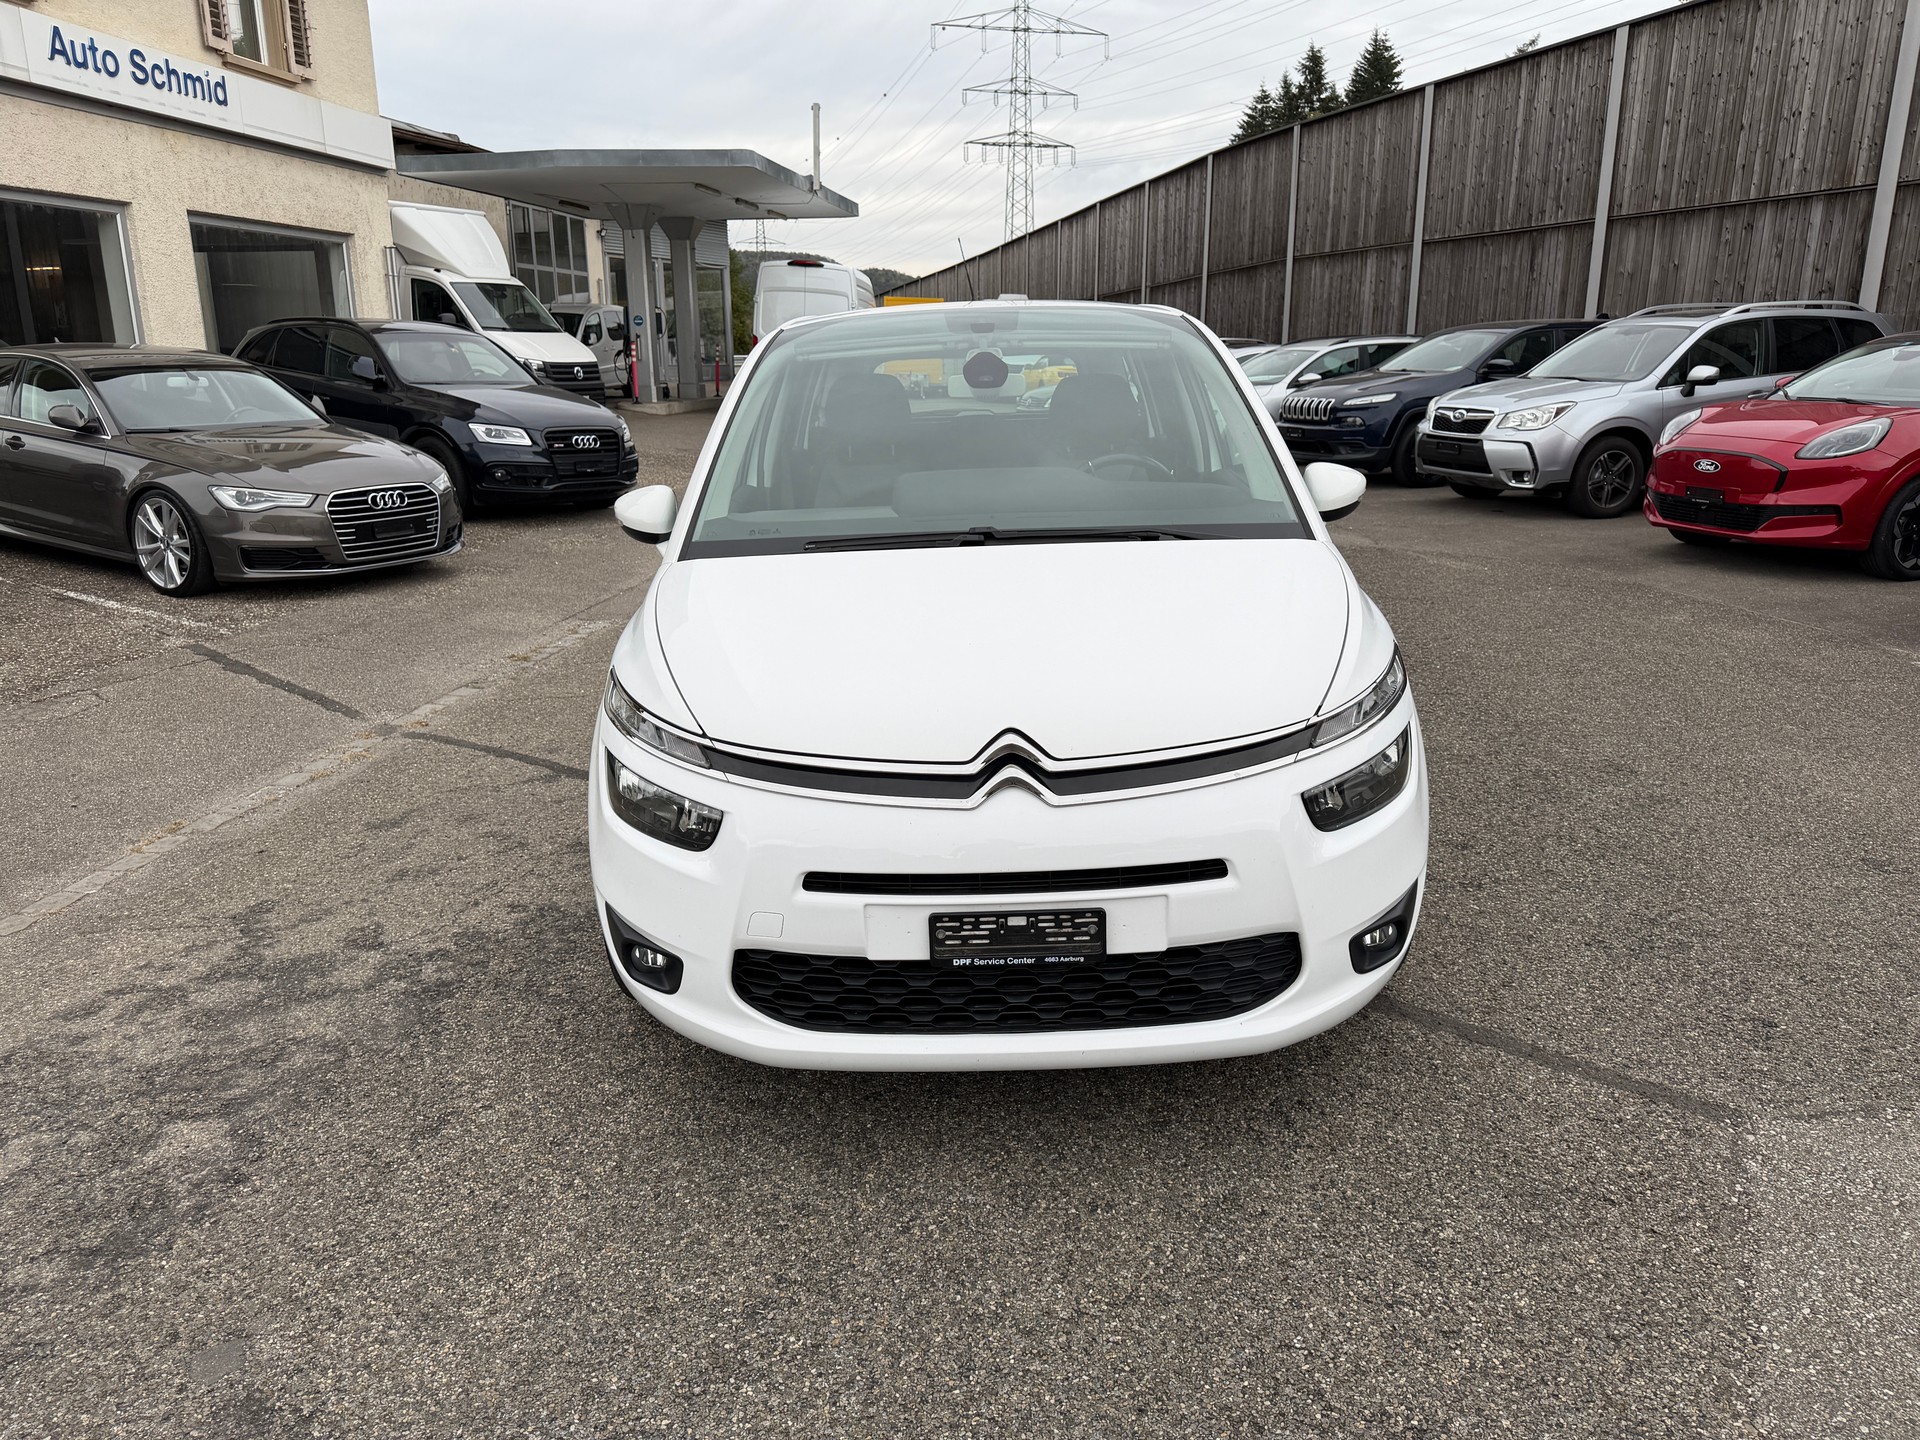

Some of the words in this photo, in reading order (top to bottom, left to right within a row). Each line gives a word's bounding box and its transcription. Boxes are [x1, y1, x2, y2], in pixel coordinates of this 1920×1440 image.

[48, 25, 120, 78] Auto
[129, 49, 229, 107] Schmid
[953, 958, 972, 966] DPF
[973, 957, 1005, 966] Service
[1006, 956, 1036, 965] Center
